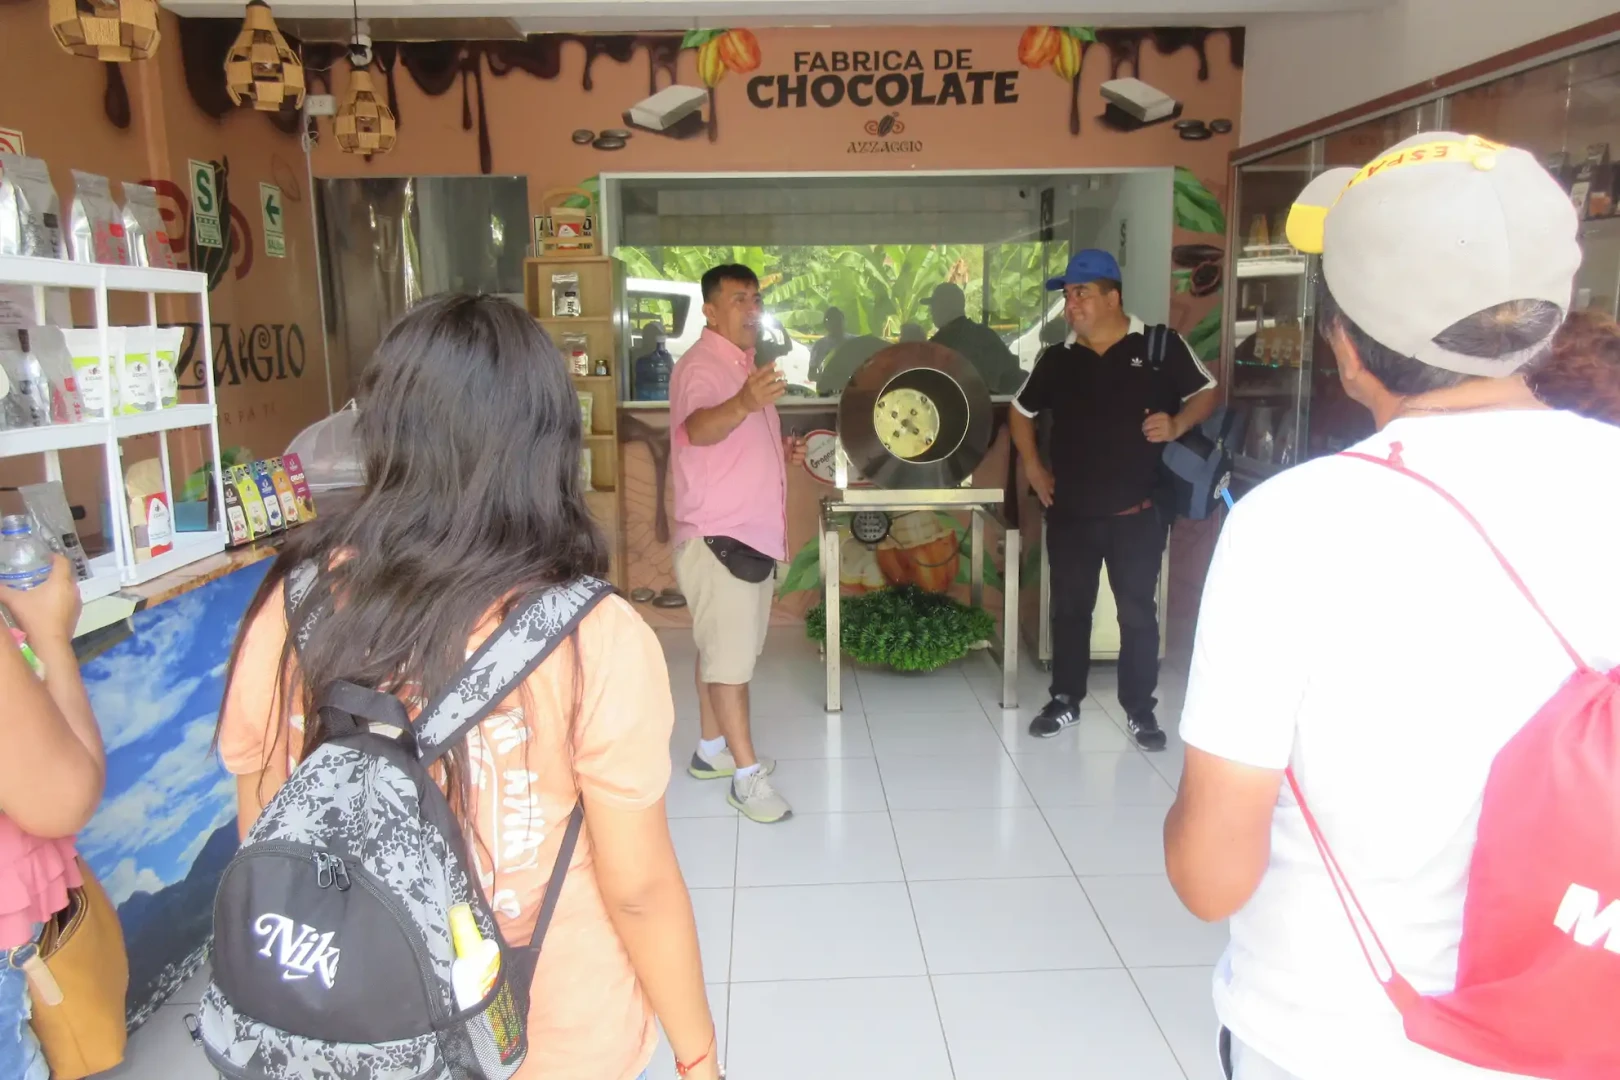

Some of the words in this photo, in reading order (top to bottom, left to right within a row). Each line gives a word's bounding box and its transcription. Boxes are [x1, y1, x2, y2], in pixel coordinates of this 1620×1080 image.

[794, 49, 924, 73] FABRICA
[934, 48, 973, 70] DE
[747, 70, 1019, 108] CHOCOLATE
[847, 140, 923, 154] AZZAGGIO
[196, 169, 213, 212] S
[254, 912, 340, 989] Nik
